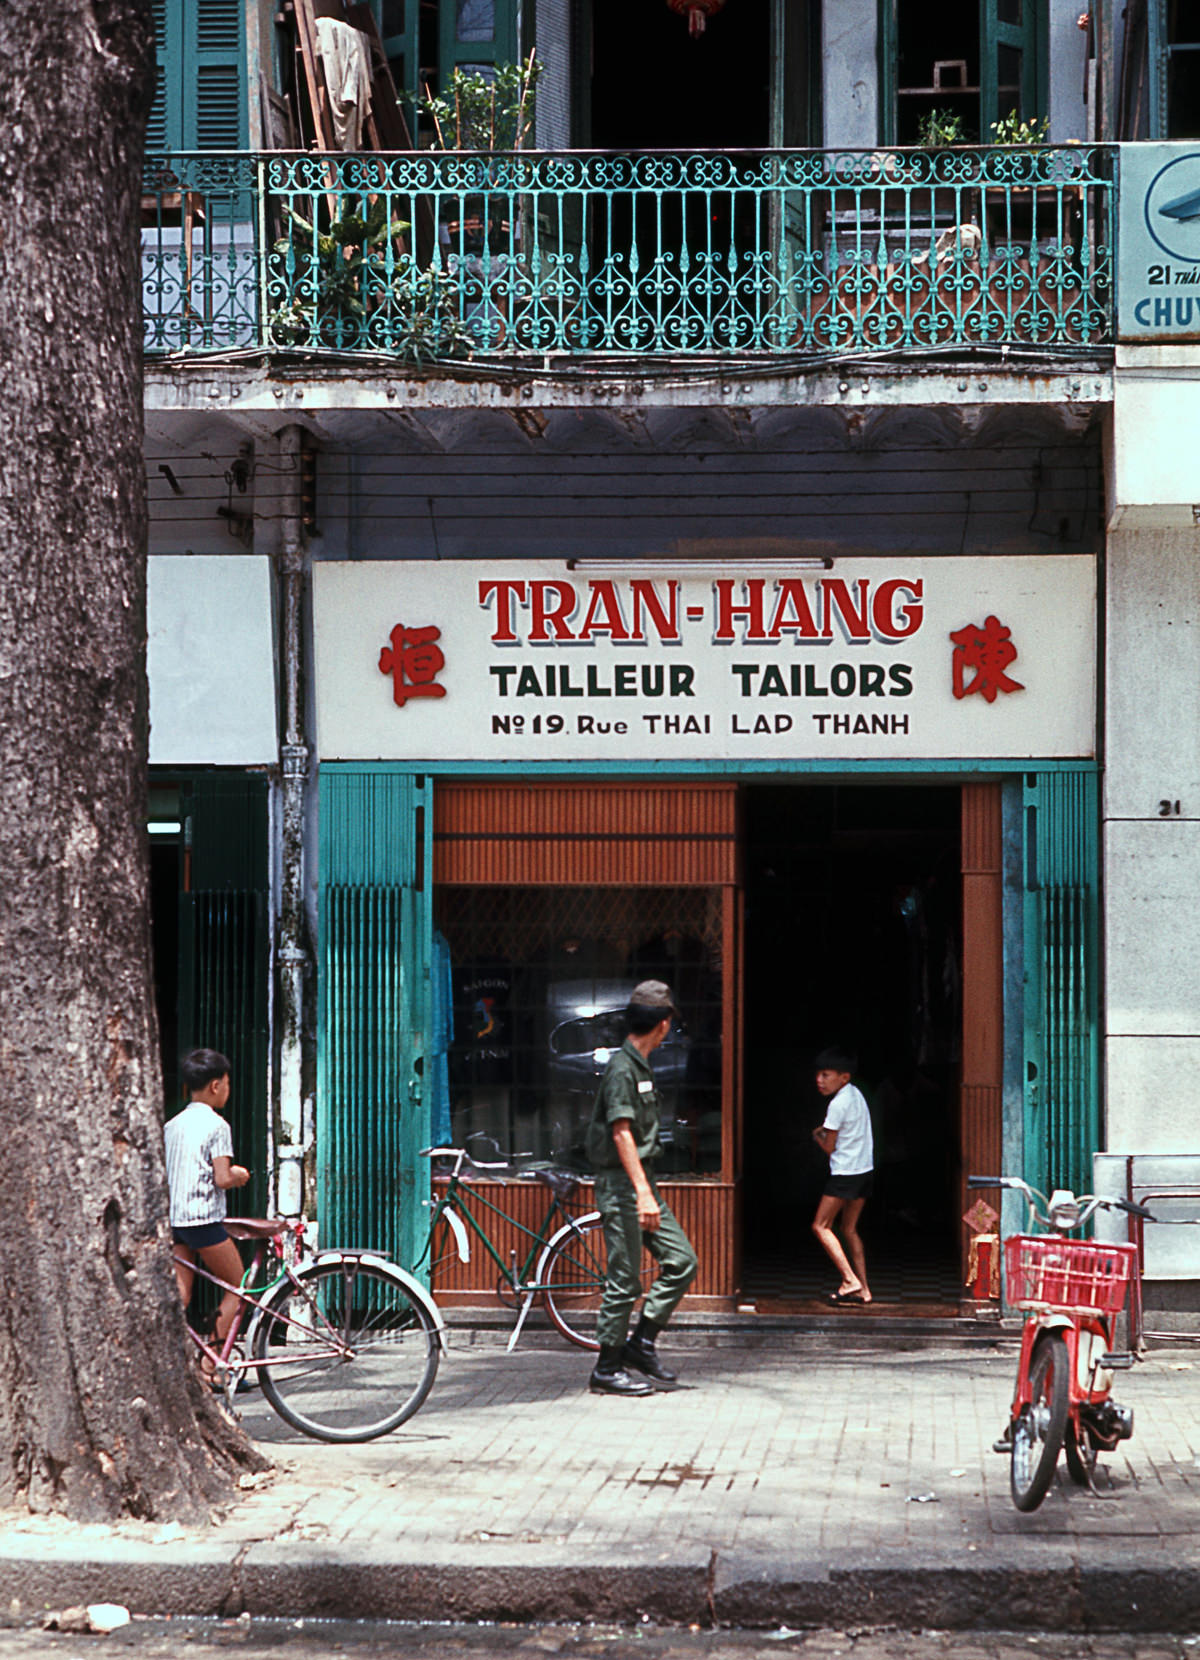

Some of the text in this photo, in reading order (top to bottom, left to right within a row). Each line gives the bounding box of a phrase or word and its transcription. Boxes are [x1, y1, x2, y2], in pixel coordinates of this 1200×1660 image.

[1147, 265, 1171, 285] 21
[478, 578, 925, 647] TRAN-HANG
[949, 615, 1026, 703] 陳
[489, 663, 914, 697] TAILLEUR TAILORS
[577, 714, 629, 735] Rue
[642, 714, 711, 735] THAI
[812, 714, 910, 735] THANH
[1158, 800, 1181, 817] 21
